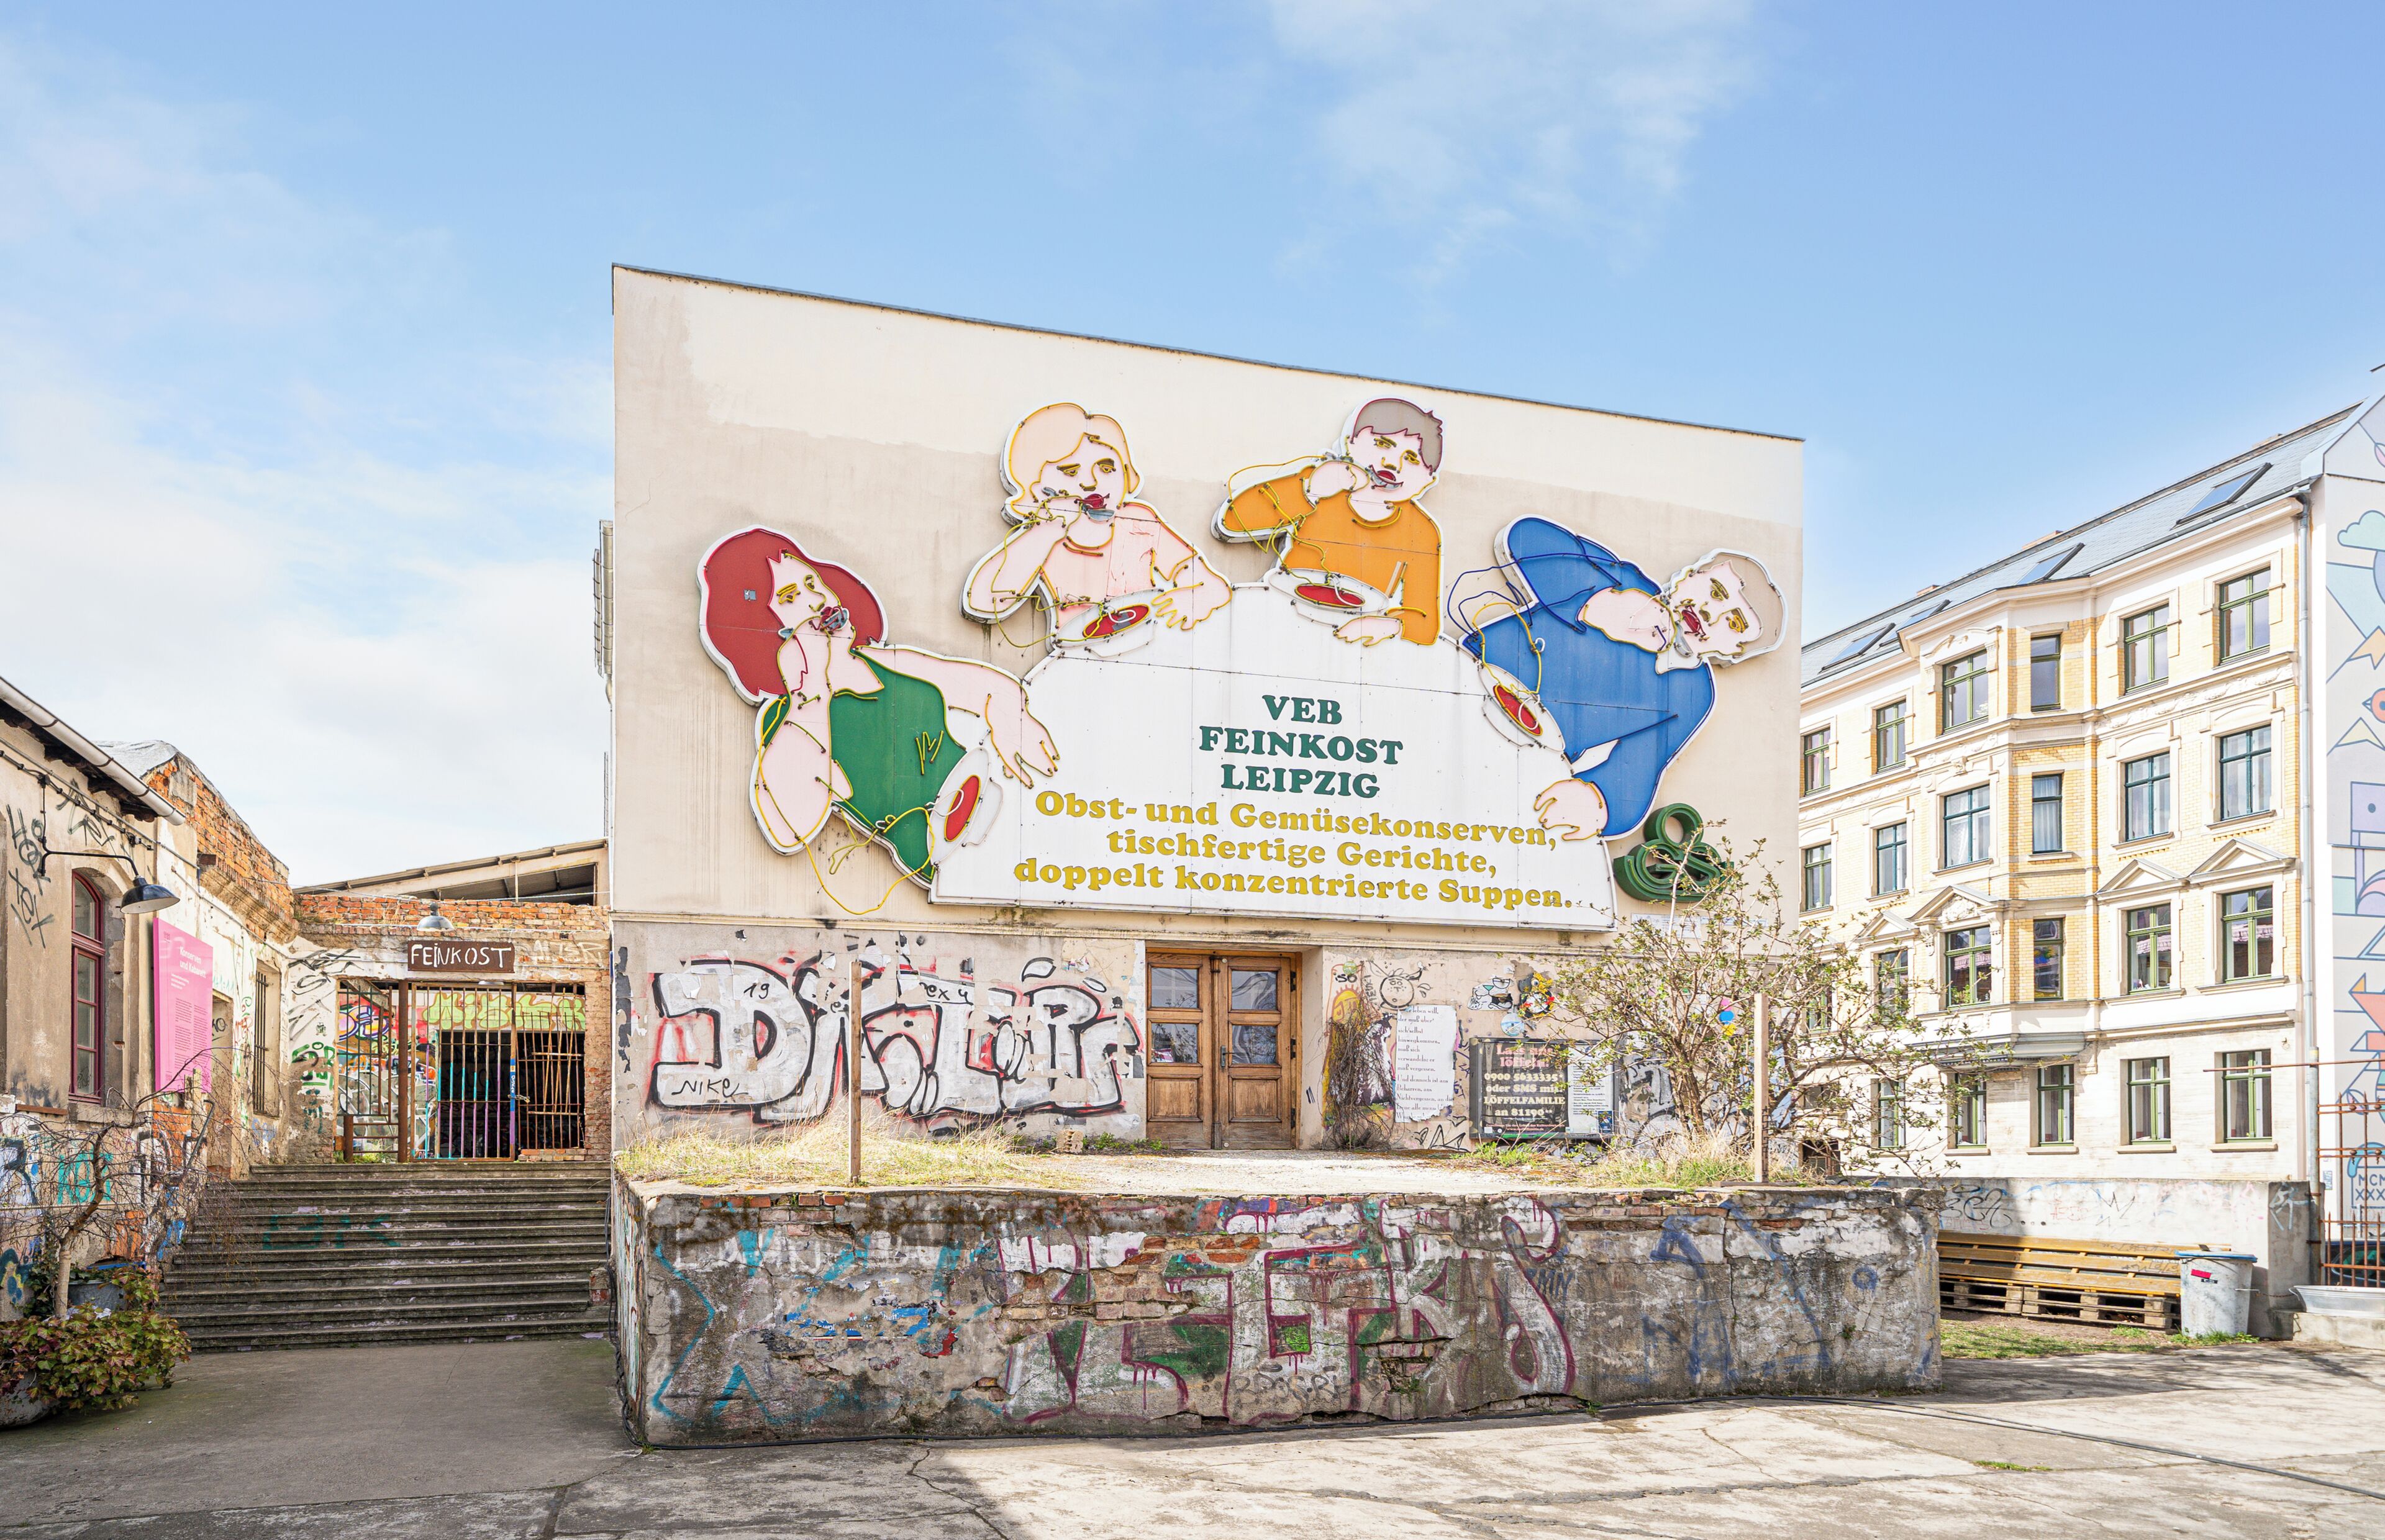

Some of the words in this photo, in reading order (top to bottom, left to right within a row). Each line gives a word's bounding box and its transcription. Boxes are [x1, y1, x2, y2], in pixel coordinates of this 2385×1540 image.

[1262, 695, 1342, 725] VEB
[1199, 726, 1403, 764] FEINKOST
[1221, 764, 1379, 798] LEIPZIG
[1035, 790, 1137, 820] Obst-
[1145, 802, 1218, 825] und
[1230, 803, 1556, 851] Gemüsekonserven,
[1106, 828, 1325, 867] tischfertige
[1337, 841, 1497, 878] Gerichte,
[1014, 857, 1164, 891] doppelt
[1175, 864, 1429, 901] konzentrierte
[1438, 878, 1572, 911] Suppen.
[179, 946, 201, 964] Konserven
[411, 943, 512, 968] FEINKOST
[179, 960, 188, 970] und
[188, 962, 206, 979] Kabarett
[1410, 1075, 1431, 1083] dennoch
[1484, 1072, 1510, 1082] 0900
[1486, 1084, 1510, 1092] oder
[1513, 1084, 1537, 1092] SMS
[1483, 1095, 1566, 1105] LÖFFELFAMILIE
